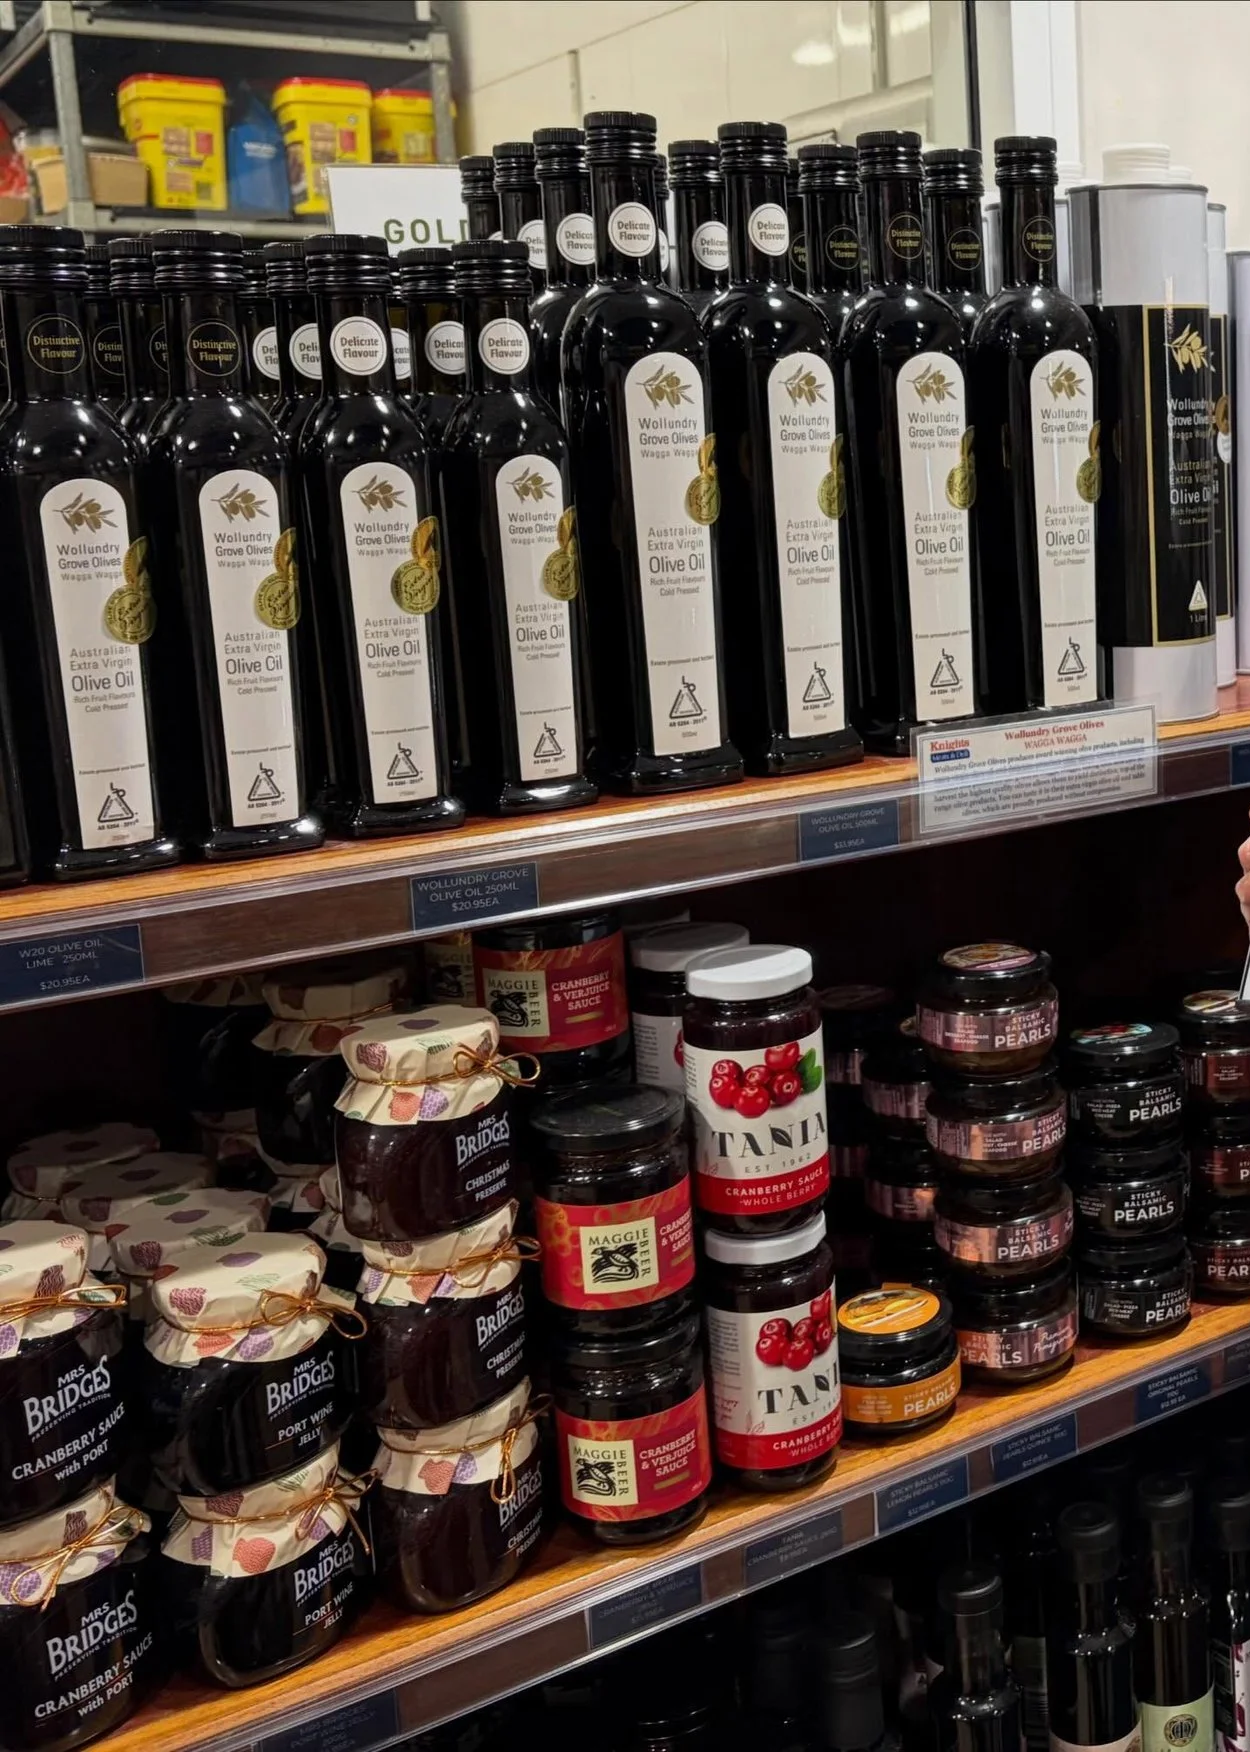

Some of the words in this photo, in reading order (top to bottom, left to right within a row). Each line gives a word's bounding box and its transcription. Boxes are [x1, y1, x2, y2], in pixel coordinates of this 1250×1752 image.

[617, 221, 651, 232] Delicate
[619, 231, 650, 242] Flavour
[32, 334, 82, 347] Distinctive
[191, 339, 237, 351] Distinctive
[339, 336, 380, 348] Delicate
[487, 337, 524, 348] Delicate
[40, 347, 78, 360] Flavour
[199, 351, 233, 364] Flavour
[342, 346, 380, 360] Flavour
[490, 348, 524, 360] Flavour
[638, 417, 698, 434] Wollundry
[779, 414, 830, 429] Wollundry
[907, 412, 960, 426] Wollundry
[639, 433, 669, 446] Grove
[671, 431, 699, 444] Olives
[780, 429, 807, 441] Grove
[808, 427, 831, 440] Olives
[908, 426, 934, 438] Grove
[936, 424, 960, 436] Olives
[354, 522, 410, 536] Wollundry
[647, 525, 703, 538] Australian
[214, 532, 273, 545] Wollundry
[355, 535, 382, 547] Grove
[384, 533, 411, 546] Olives
[647, 539, 674, 551] Extra
[676, 537, 704, 551] Virgin
[914, 538, 948, 555] Olive
[949, 536, 964, 553] Oil
[56, 543, 121, 557] Wollundry
[215, 545, 244, 557] Grove
[246, 543, 273, 556] Olives
[786, 545, 819, 564] Olive
[821, 544, 835, 562] Oil
[58, 558, 89, 571] Grove
[91, 556, 122, 568] Olives
[649, 554, 686, 574] Olive
[688, 552, 705, 572] Oil
[70, 644, 131, 658] Australian
[365, 643, 402, 660] Olive
[403, 640, 421, 656] Oil
[70, 660, 99, 672] Extra
[102, 657, 133, 670] Virgin
[225, 658, 263, 676] Olive
[265, 655, 284, 672] Oil
[71, 674, 112, 692] Olive
[115, 671, 135, 688] Oil
[1005, 728, 1050, 741] Wollundry
[1052, 723, 1078, 735] Grove
[1079, 720, 1104, 731] Olives
[930, 739, 970, 752] Knights
[1024, 739, 1055, 750] WAGGA
[1056, 733, 1087, 745] WAGGA
[418, 875, 489, 892] WOLLUNDRY
[491, 867, 529, 880] GROVE
[429, 890, 462, 903] OLIVE
[464, 887, 483, 897] OIL
[485, 881, 519, 895] 250ML
[452, 897, 500, 912] $20.95EA
[47, 942, 82, 954] OLIVE
[83, 939, 104, 949] OIL
[26, 958, 54, 969] LIME
[62, 951, 98, 964] 250ML
[40, 974, 91, 990] $20.95EA
[487, 976, 539, 992] MAGGIE
[551, 970, 610, 992] CRANBERRY
[553, 994, 561, 1002] &
[562, 981, 611, 1000] VERJUICE
[529, 991, 541, 1028] BEER
[567, 995, 602, 1011] SAUCE
[995, 1024, 1051, 1049] PEARLS
[1145, 1086, 1173, 1098] STICKY
[1129, 1097, 1182, 1123] PEARLS
[477, 1114, 497, 1131] MRS
[455, 1110, 510, 1166] BRIDGES
[711, 1111, 827, 1158] TANIA
[465, 1159, 510, 1192] CHRISTMAS
[744, 1164, 772, 1174] EST
[475, 1178, 508, 1202] PRESERVE
[725, 1180, 794, 1197] CRANBERRY
[798, 1166, 823, 1186] SAUCE
[1114, 1201, 1175, 1223] PEARLS
[293, 1356, 317, 1377] MRS
[57, 1364, 86, 1388] MRS
[265, 1350, 336, 1415] BRIDGES
[22, 1354, 112, 1437] BRIDGES
[903, 1383, 956, 1417] PEARLS
[277, 1420, 308, 1442] PORT
[310, 1401, 335, 1427] WINE
[11, 1430, 97, 1482] CRANBERRY
[98, 1401, 126, 1438] SAUCE
[298, 1427, 322, 1447] JELLY
[639, 1429, 696, 1461] CRANBERRY
[54, 1462, 82, 1482] with
[82, 1439, 110, 1471] PORT
[574, 1447, 627, 1460] MAGGIE
[641, 1461, 650, 1471] &
[651, 1442, 696, 1468] VERJUICE
[655, 1458, 689, 1478] SAUCE
[617, 1460, 630, 1496] BEER
[81, 1601, 111, 1628] MRS
[46, 1589, 138, 1675] BRIDGES
[34, 1662, 121, 1719] CRANBERRY
[122, 1631, 154, 1669] SAUCE
[77, 1696, 105, 1718] with
[106, 1671, 134, 1702] PORT
